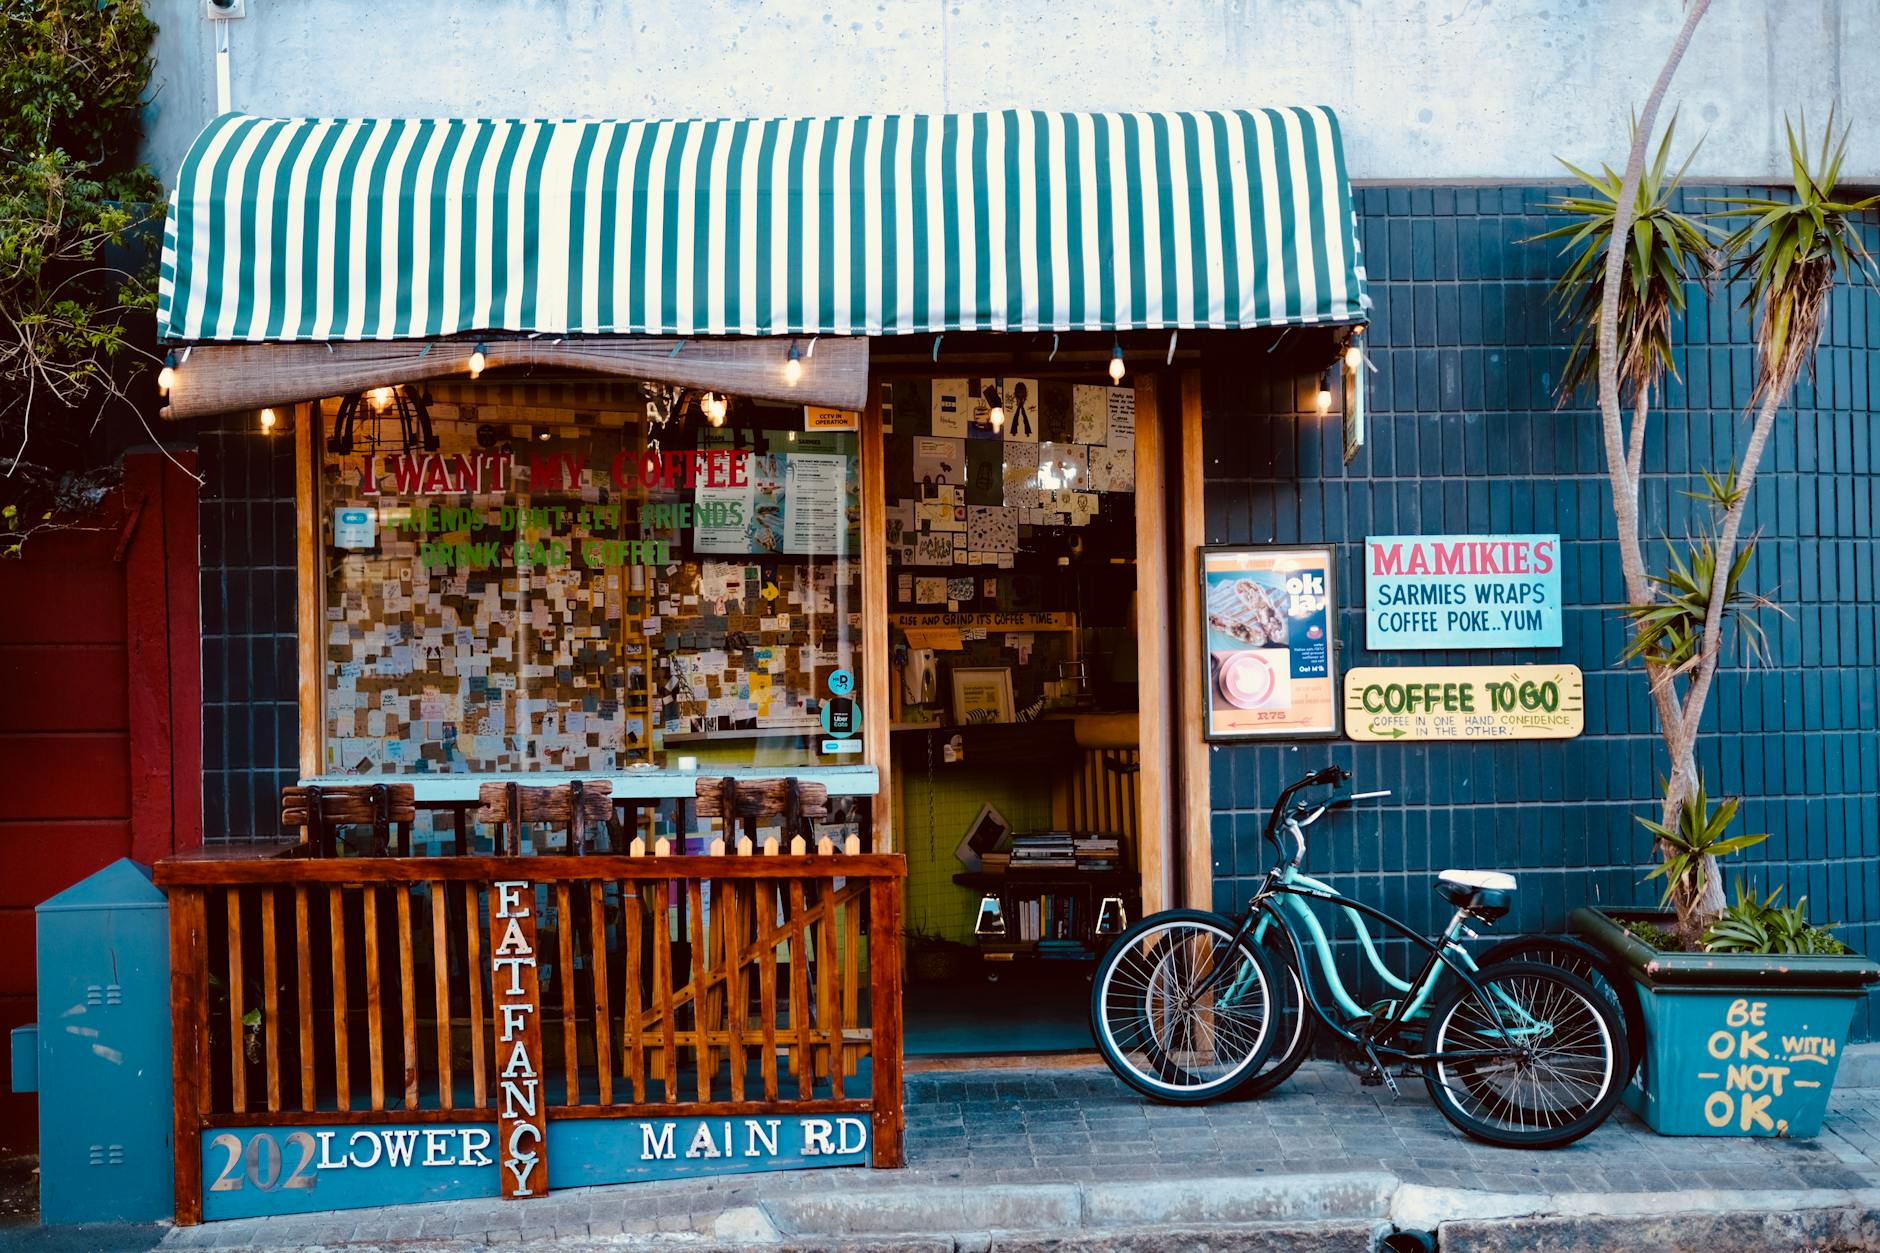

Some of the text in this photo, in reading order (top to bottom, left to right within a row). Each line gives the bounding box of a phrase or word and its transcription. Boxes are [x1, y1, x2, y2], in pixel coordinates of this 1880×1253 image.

[362, 454, 381, 495] I
[389, 452, 514, 495] WANT
[529, 451, 586, 491] MY
[612, 448, 749, 489] COFFEE
[386, 507, 484, 533] FRIENDS
[501, 506, 568, 532] DONT
[580, 503, 621, 530] LET
[642, 501, 743, 529] FRIENDS
[420, 540, 670, 568] DRINK BAD COFFEE
[1371, 540, 1553, 576] MAMIKIES
[1378, 583, 1545, 605] SARMIES WRAPS
[900, 615, 917, 626] RISE
[922, 615, 940, 626] AND
[942, 613, 974, 626] GRIND
[994, 613, 1025, 625] COFFEE
[1378, 611, 1438, 632] COFFEE
[1362, 682, 1475, 714] COFFEE
[1257, 711, 1286, 720] R75
[1373, 714, 1570, 726] COFFEE IN ONE HAND CONFIDENCE
[1416, 726, 1428, 736] IN
[1435, 726, 1457, 736] THE
[1726, 999, 1768, 1027] BE
[493, 881, 541, 1197] EAT FANCY
[1782, 1035, 1836, 1057] WITH
[209, 1131, 318, 1192] 202
[640, 1119, 781, 1160] MAIN
[801, 1117, 867, 1156] RD
